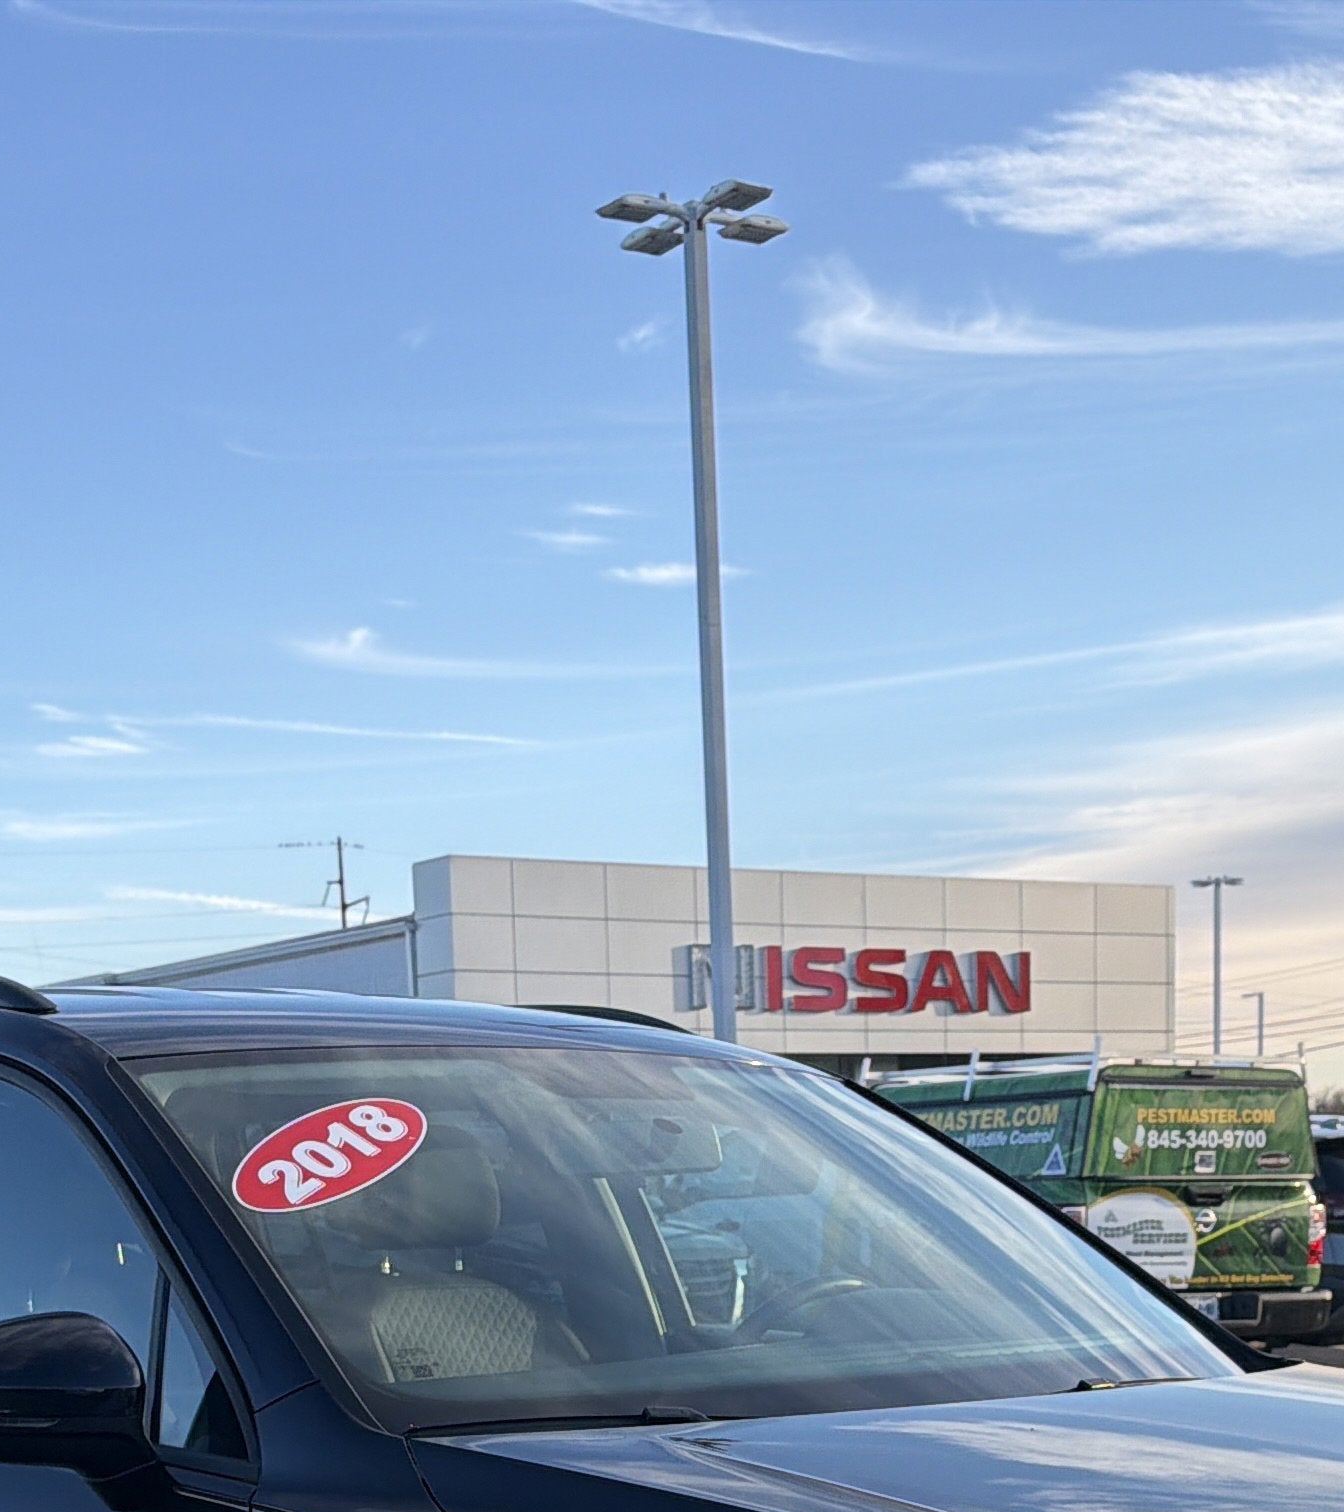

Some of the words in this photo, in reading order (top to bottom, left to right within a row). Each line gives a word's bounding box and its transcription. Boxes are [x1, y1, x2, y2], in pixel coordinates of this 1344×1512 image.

[690, 943, 1031, 1014] NISSAN
[915, 1103, 1060, 1133] MASTER.COM
[1137, 1108, 1276, 1125] PESTMASTER.COM
[1009, 1128, 1055, 1145] Control
[1147, 1129, 1267, 1149] 845-340-9700
[258, 1105, 409, 1205] 2018
